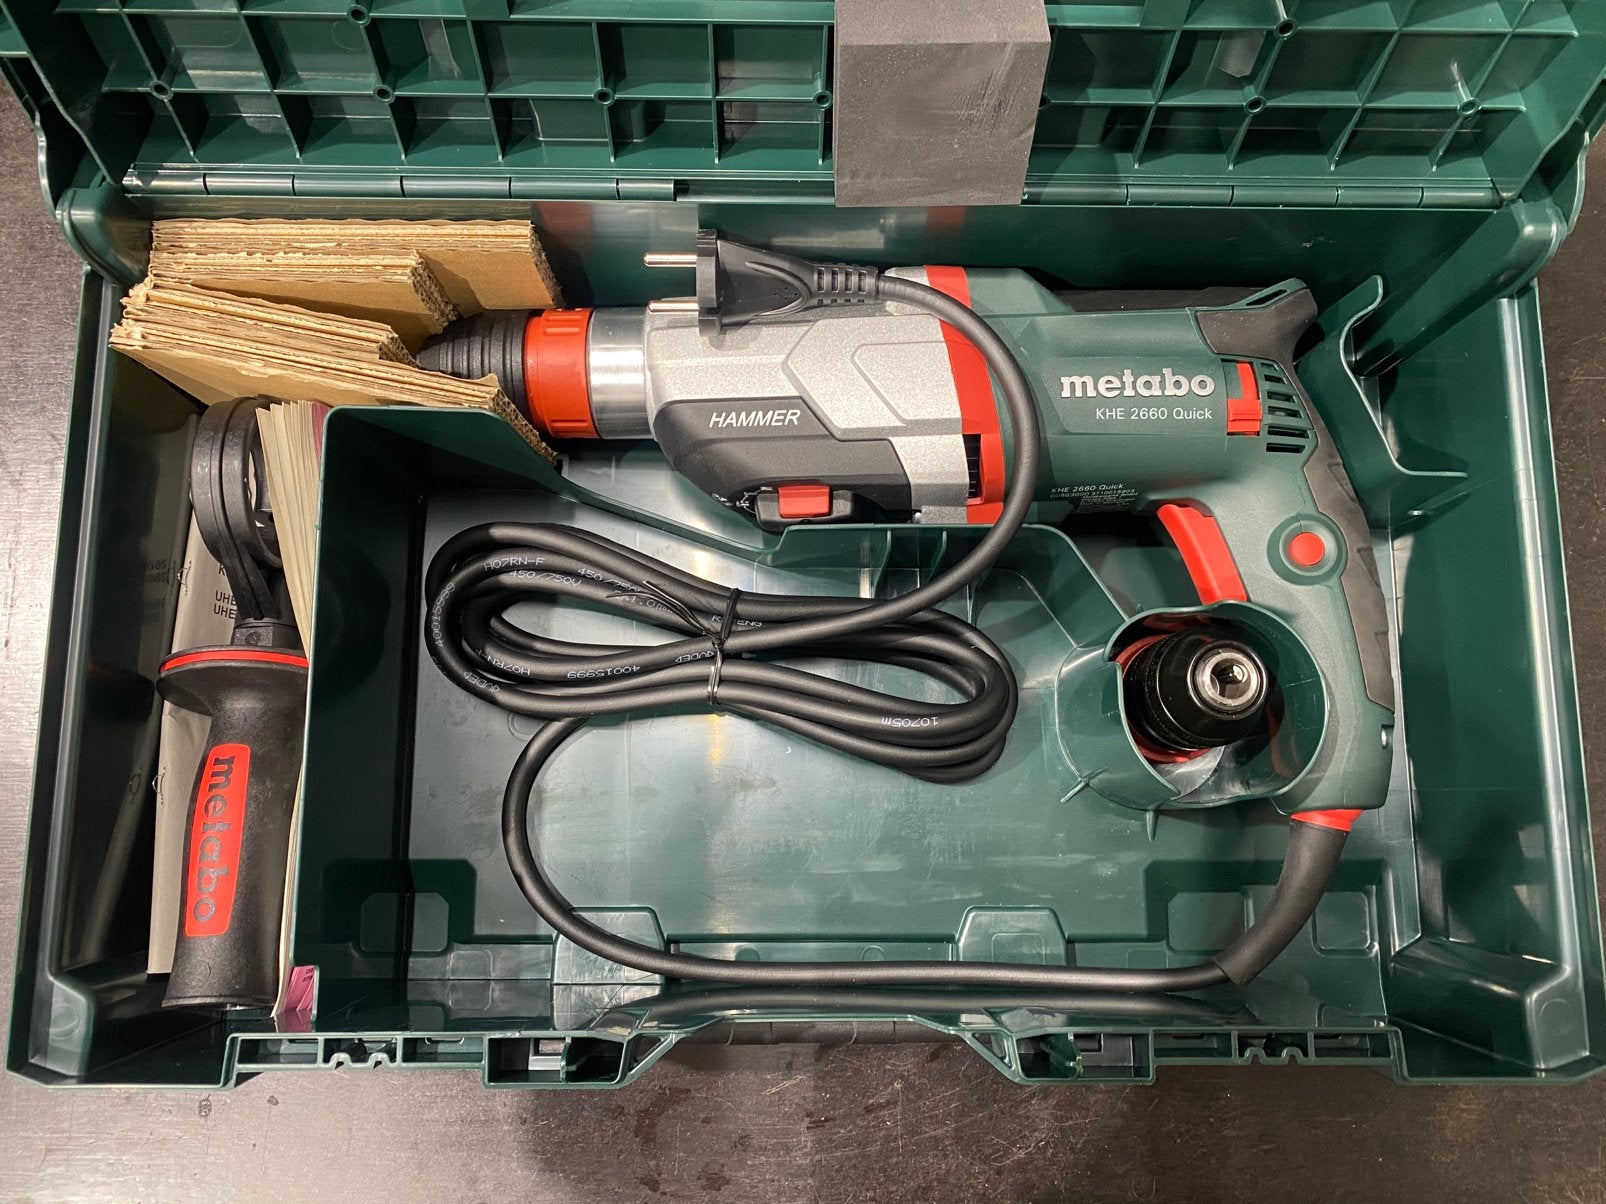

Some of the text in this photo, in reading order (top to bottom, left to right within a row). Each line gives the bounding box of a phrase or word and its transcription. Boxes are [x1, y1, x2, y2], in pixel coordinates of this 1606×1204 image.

[1060, 368, 1215, 399] metabo
[708, 409, 801, 428] HAMMER
[1095, 406, 1213, 421] KHE 2660 Quick
[1051, 483, 1124, 494] KHE 2660 Quick
[483, 556, 545, 572] H07RN-F
[213, 603, 236, 620] UHE
[566, 665, 641, 679] 40015999
[193, 755, 235, 922] metabo
